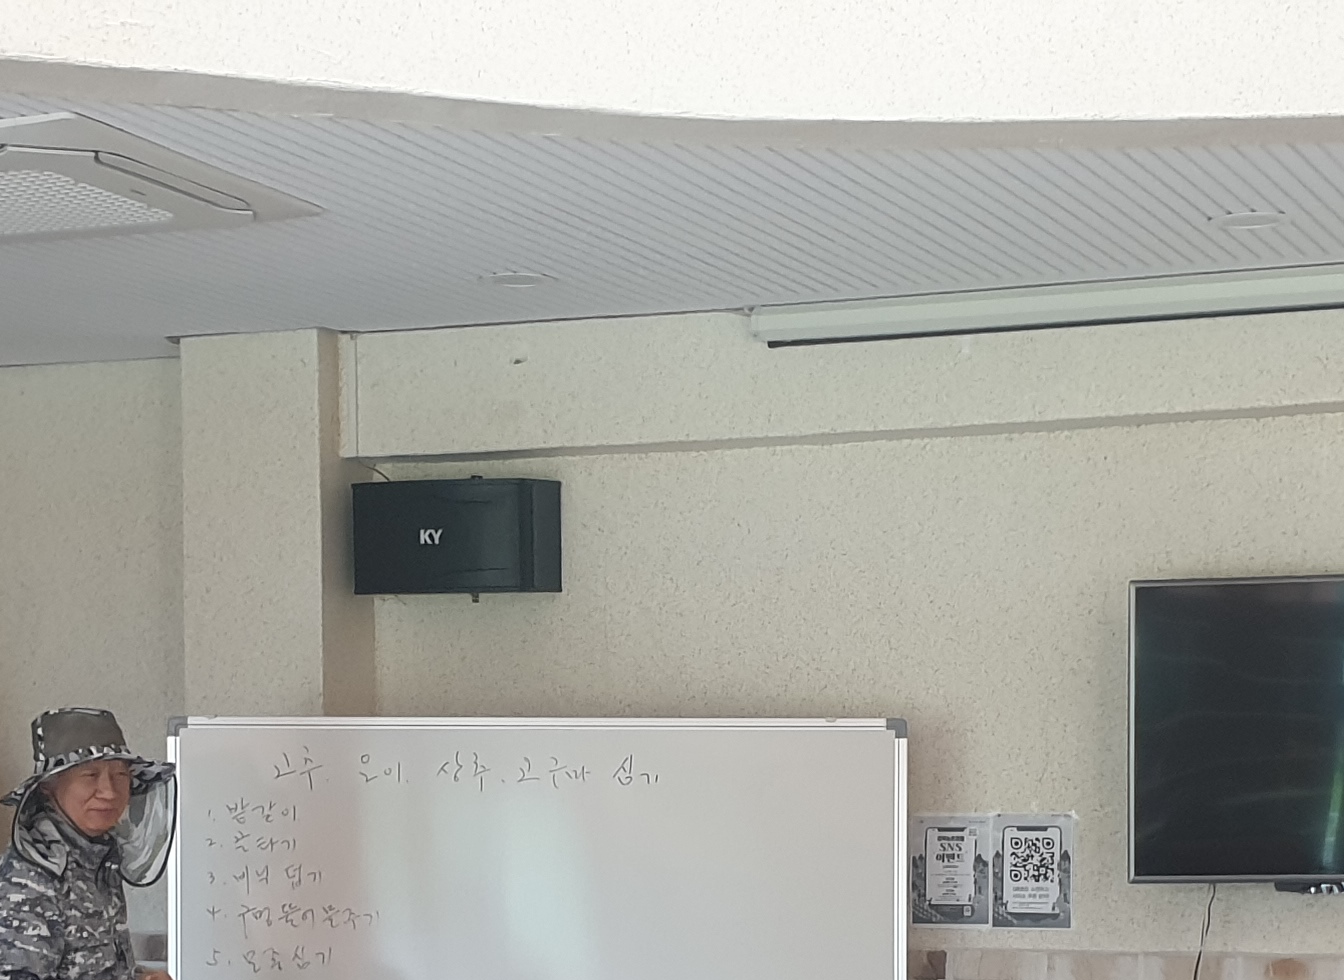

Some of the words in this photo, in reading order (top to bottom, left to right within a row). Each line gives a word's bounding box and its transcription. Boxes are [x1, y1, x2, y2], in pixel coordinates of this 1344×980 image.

[419, 528, 444, 545] KY
[611, 752, 660, 787] 심기
[207, 809, 216, 822] 1.
[205, 837, 223, 849] 2.
[939, 842, 963, 852] SNS
[207, 872, 227, 885] 3.
[206, 948, 231, 967] 5.
